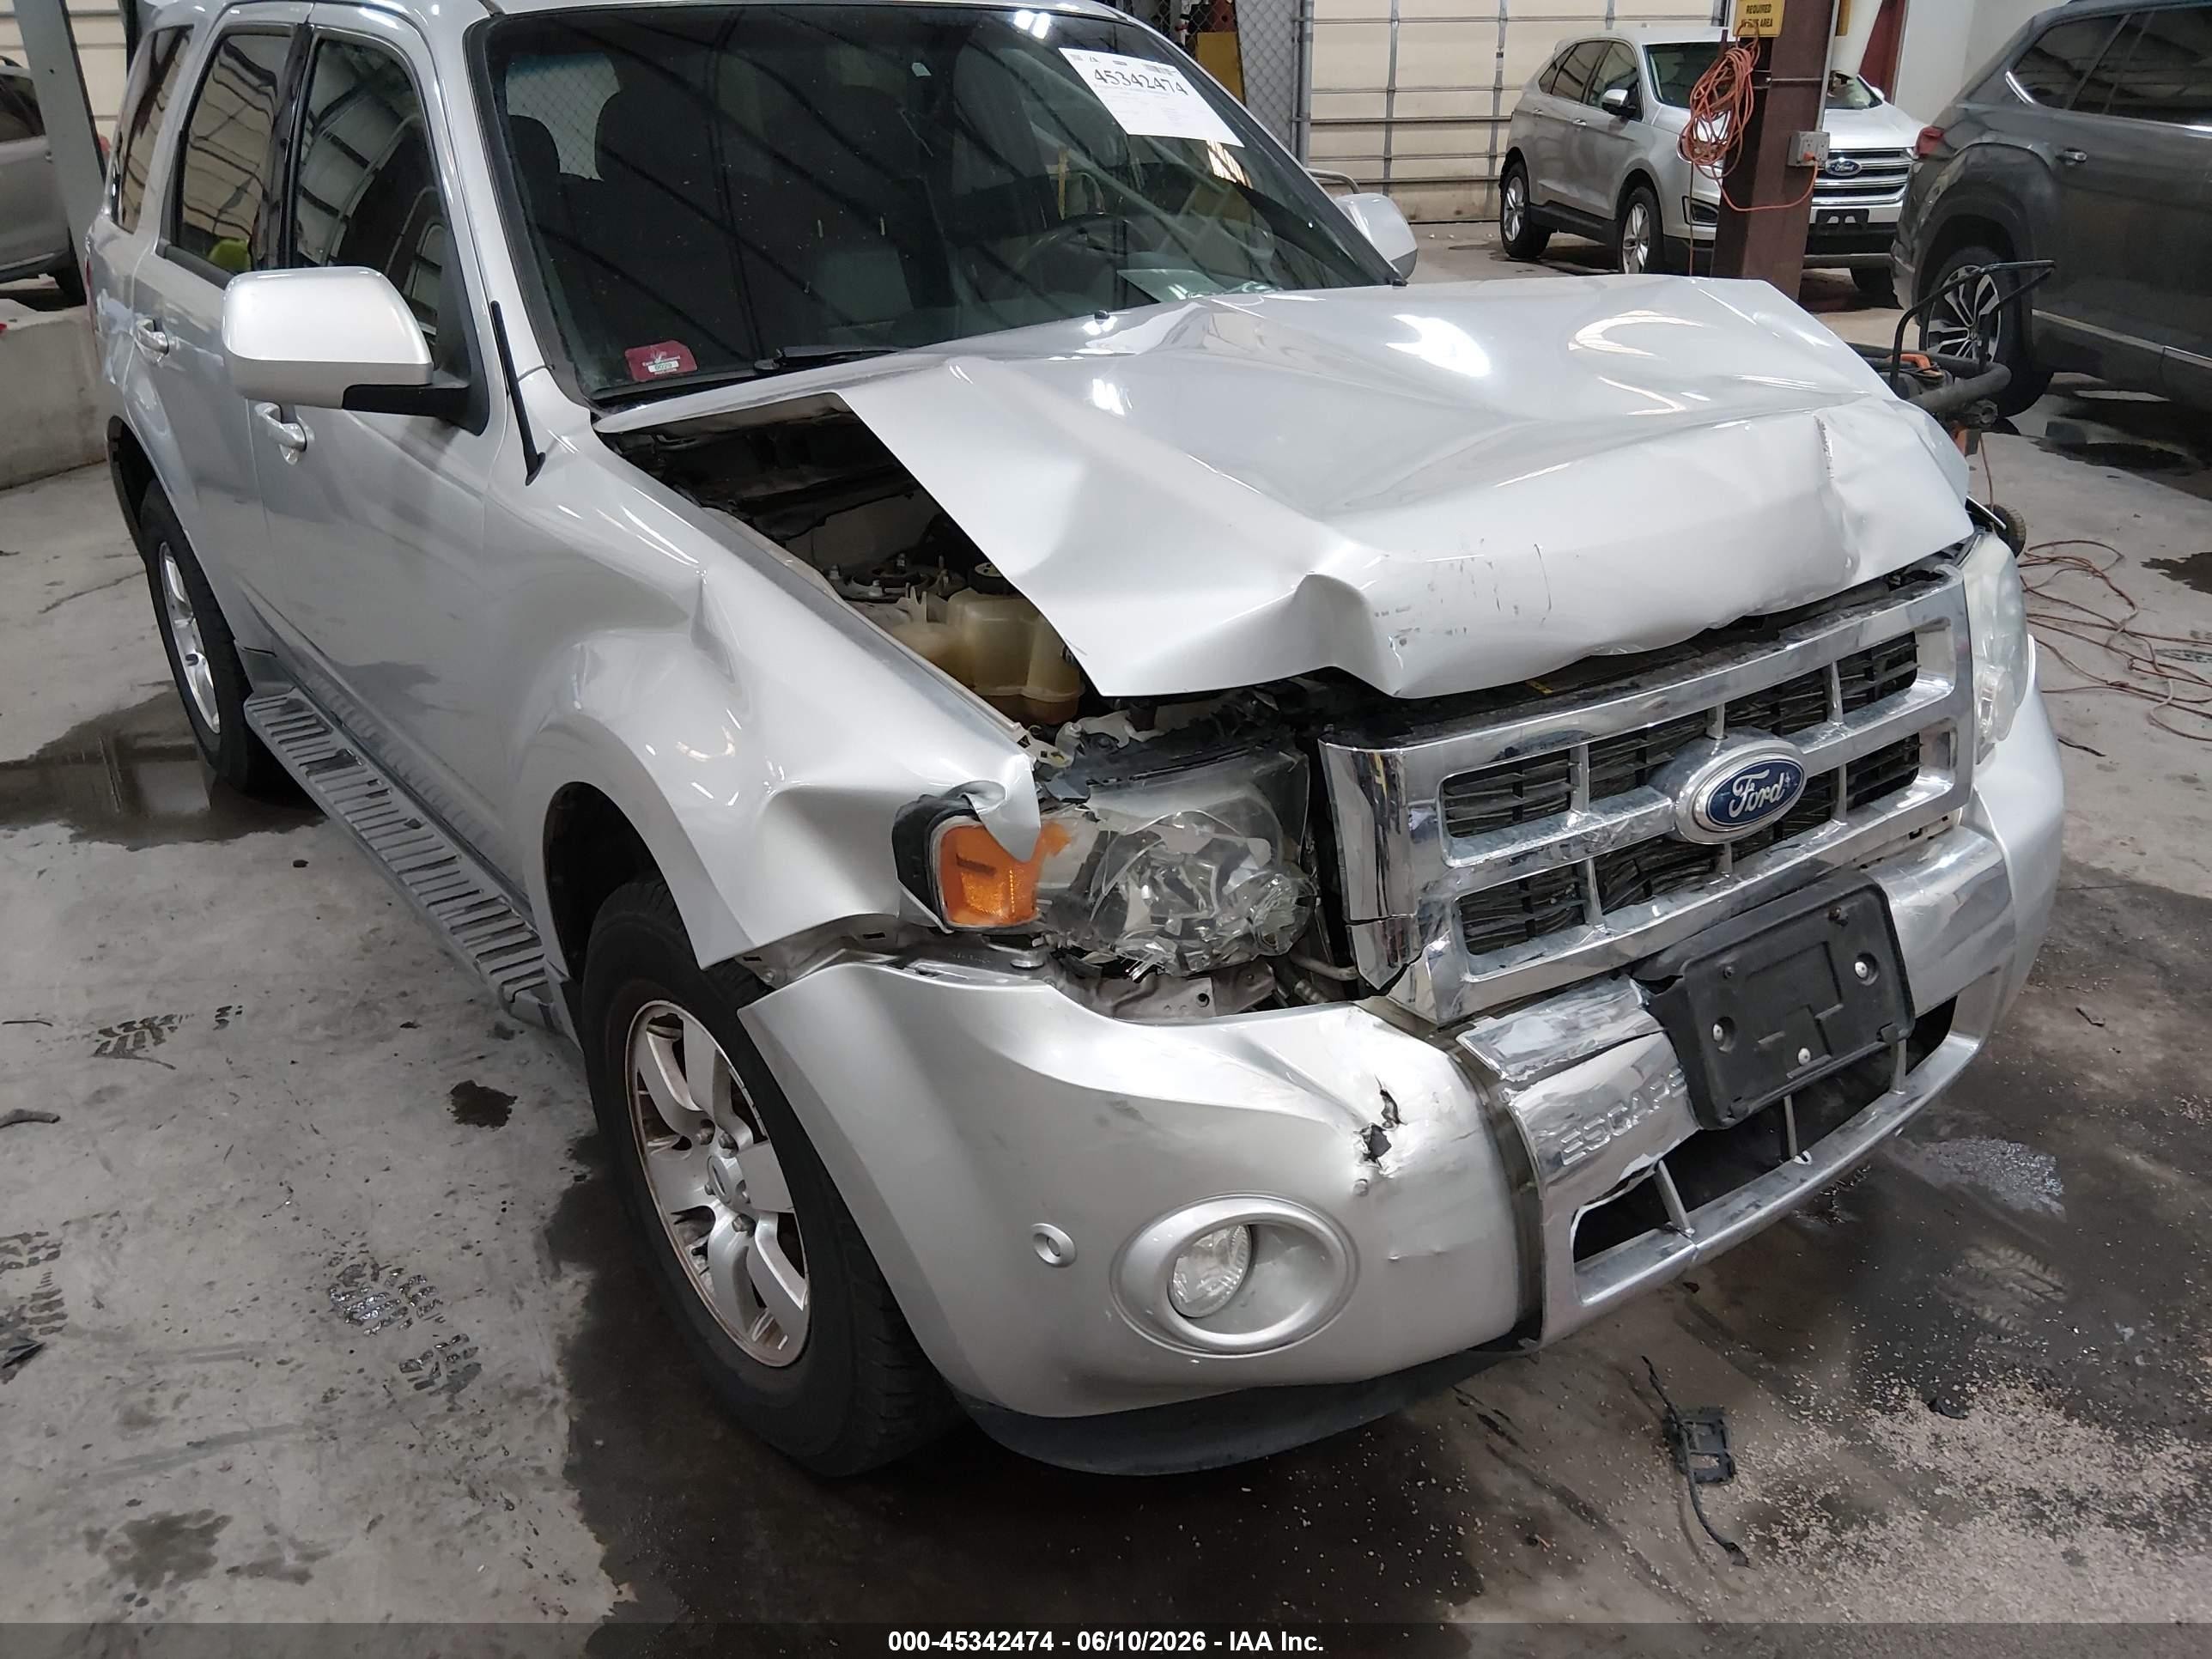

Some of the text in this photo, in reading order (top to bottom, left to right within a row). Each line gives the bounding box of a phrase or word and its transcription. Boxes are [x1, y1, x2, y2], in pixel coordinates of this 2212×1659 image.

[1746, 3, 1772, 15] REQUIRED
[1094, 69, 1188, 96] 45342474
[1834, 161, 1856, 172] Ford
[1729, 769, 1785, 817] Ford
[1560, 1068, 1687, 1165] ESCAPE
